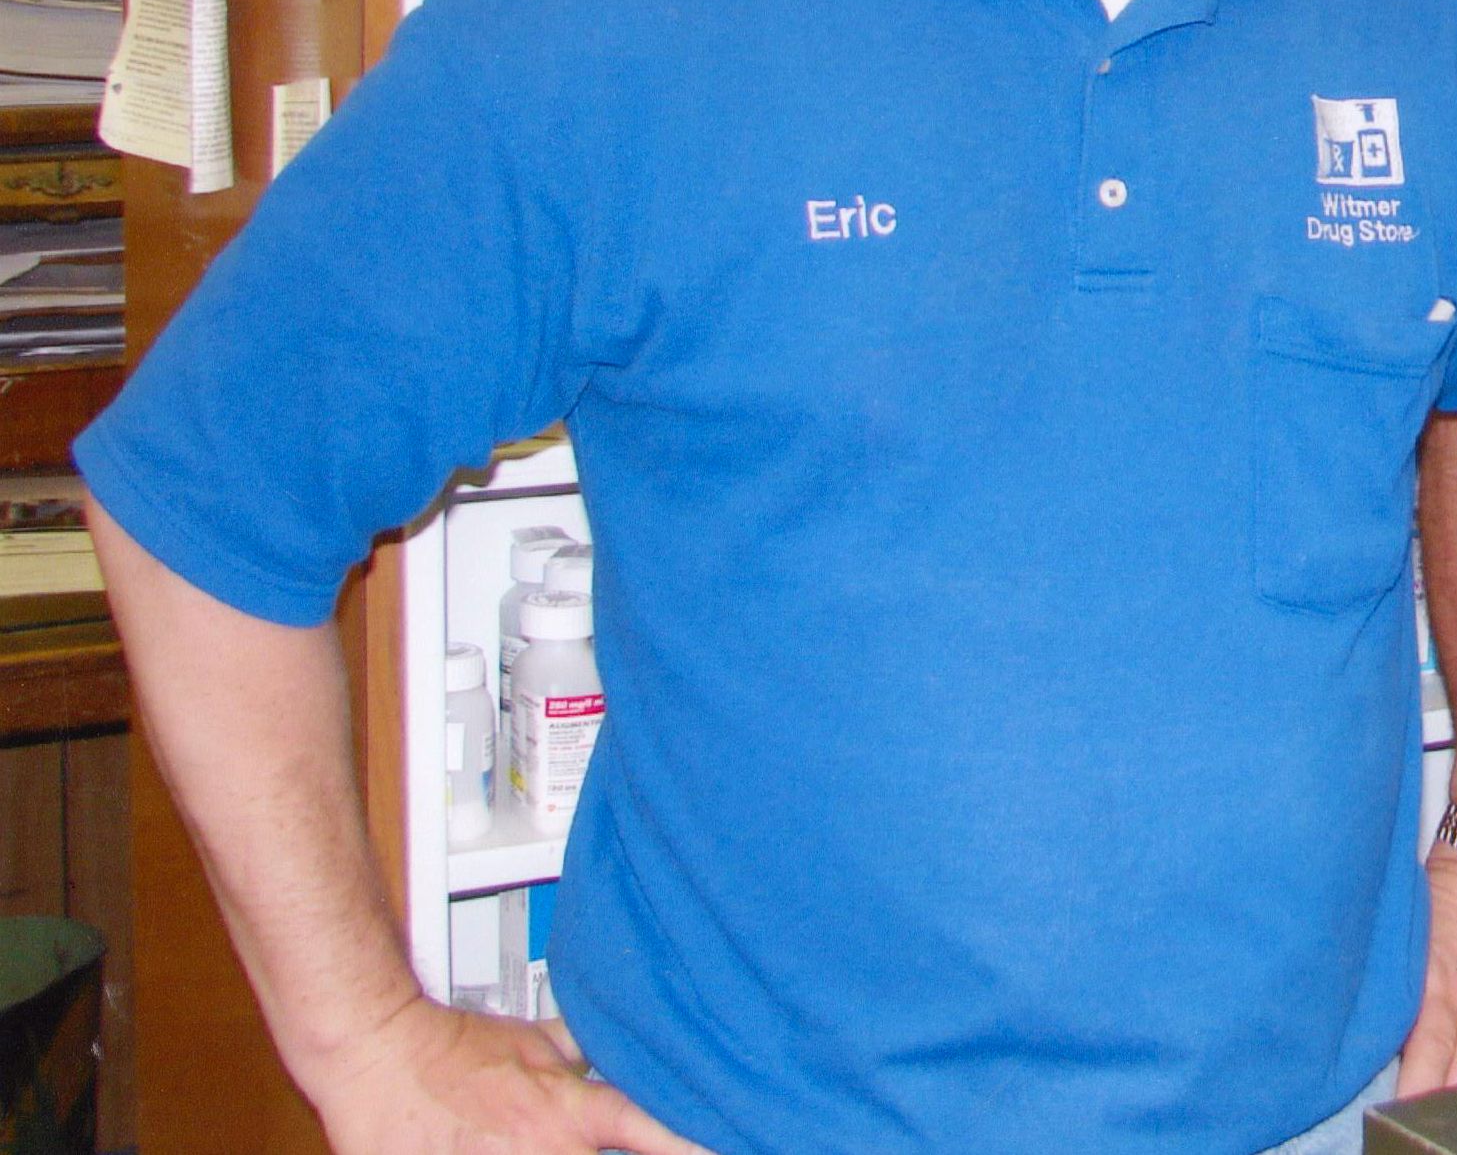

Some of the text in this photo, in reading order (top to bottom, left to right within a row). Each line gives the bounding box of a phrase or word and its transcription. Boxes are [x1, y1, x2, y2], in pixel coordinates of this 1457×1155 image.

[806, 194, 897, 240] Eric
[1321, 192, 1401, 218] Witmer
[1306, 216, 1414, 247] Drug Store
